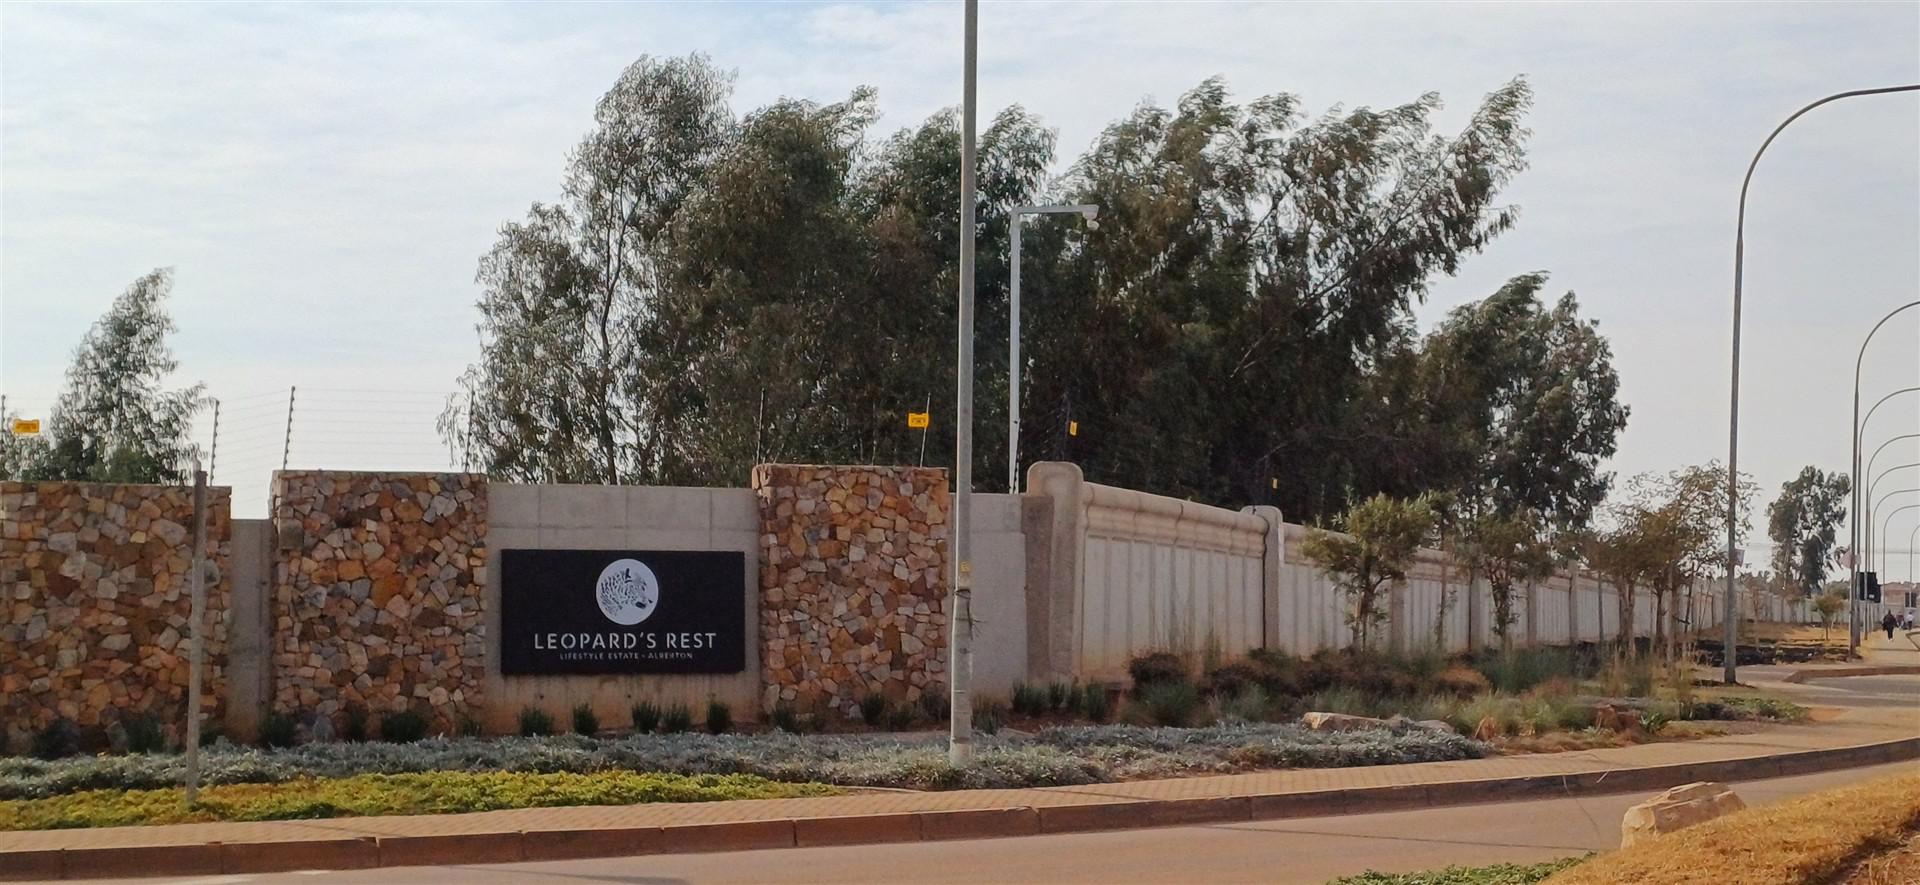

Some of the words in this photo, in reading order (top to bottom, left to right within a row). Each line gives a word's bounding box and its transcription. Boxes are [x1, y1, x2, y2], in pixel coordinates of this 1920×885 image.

[534, 632, 656, 649] LEOPARD'S
[666, 632, 717, 649] REST
[560, 652, 604, 660] LIFESTYLE
[608, 652, 639, 660] ESTATE
[648, 652, 693, 660] ALBERTON
